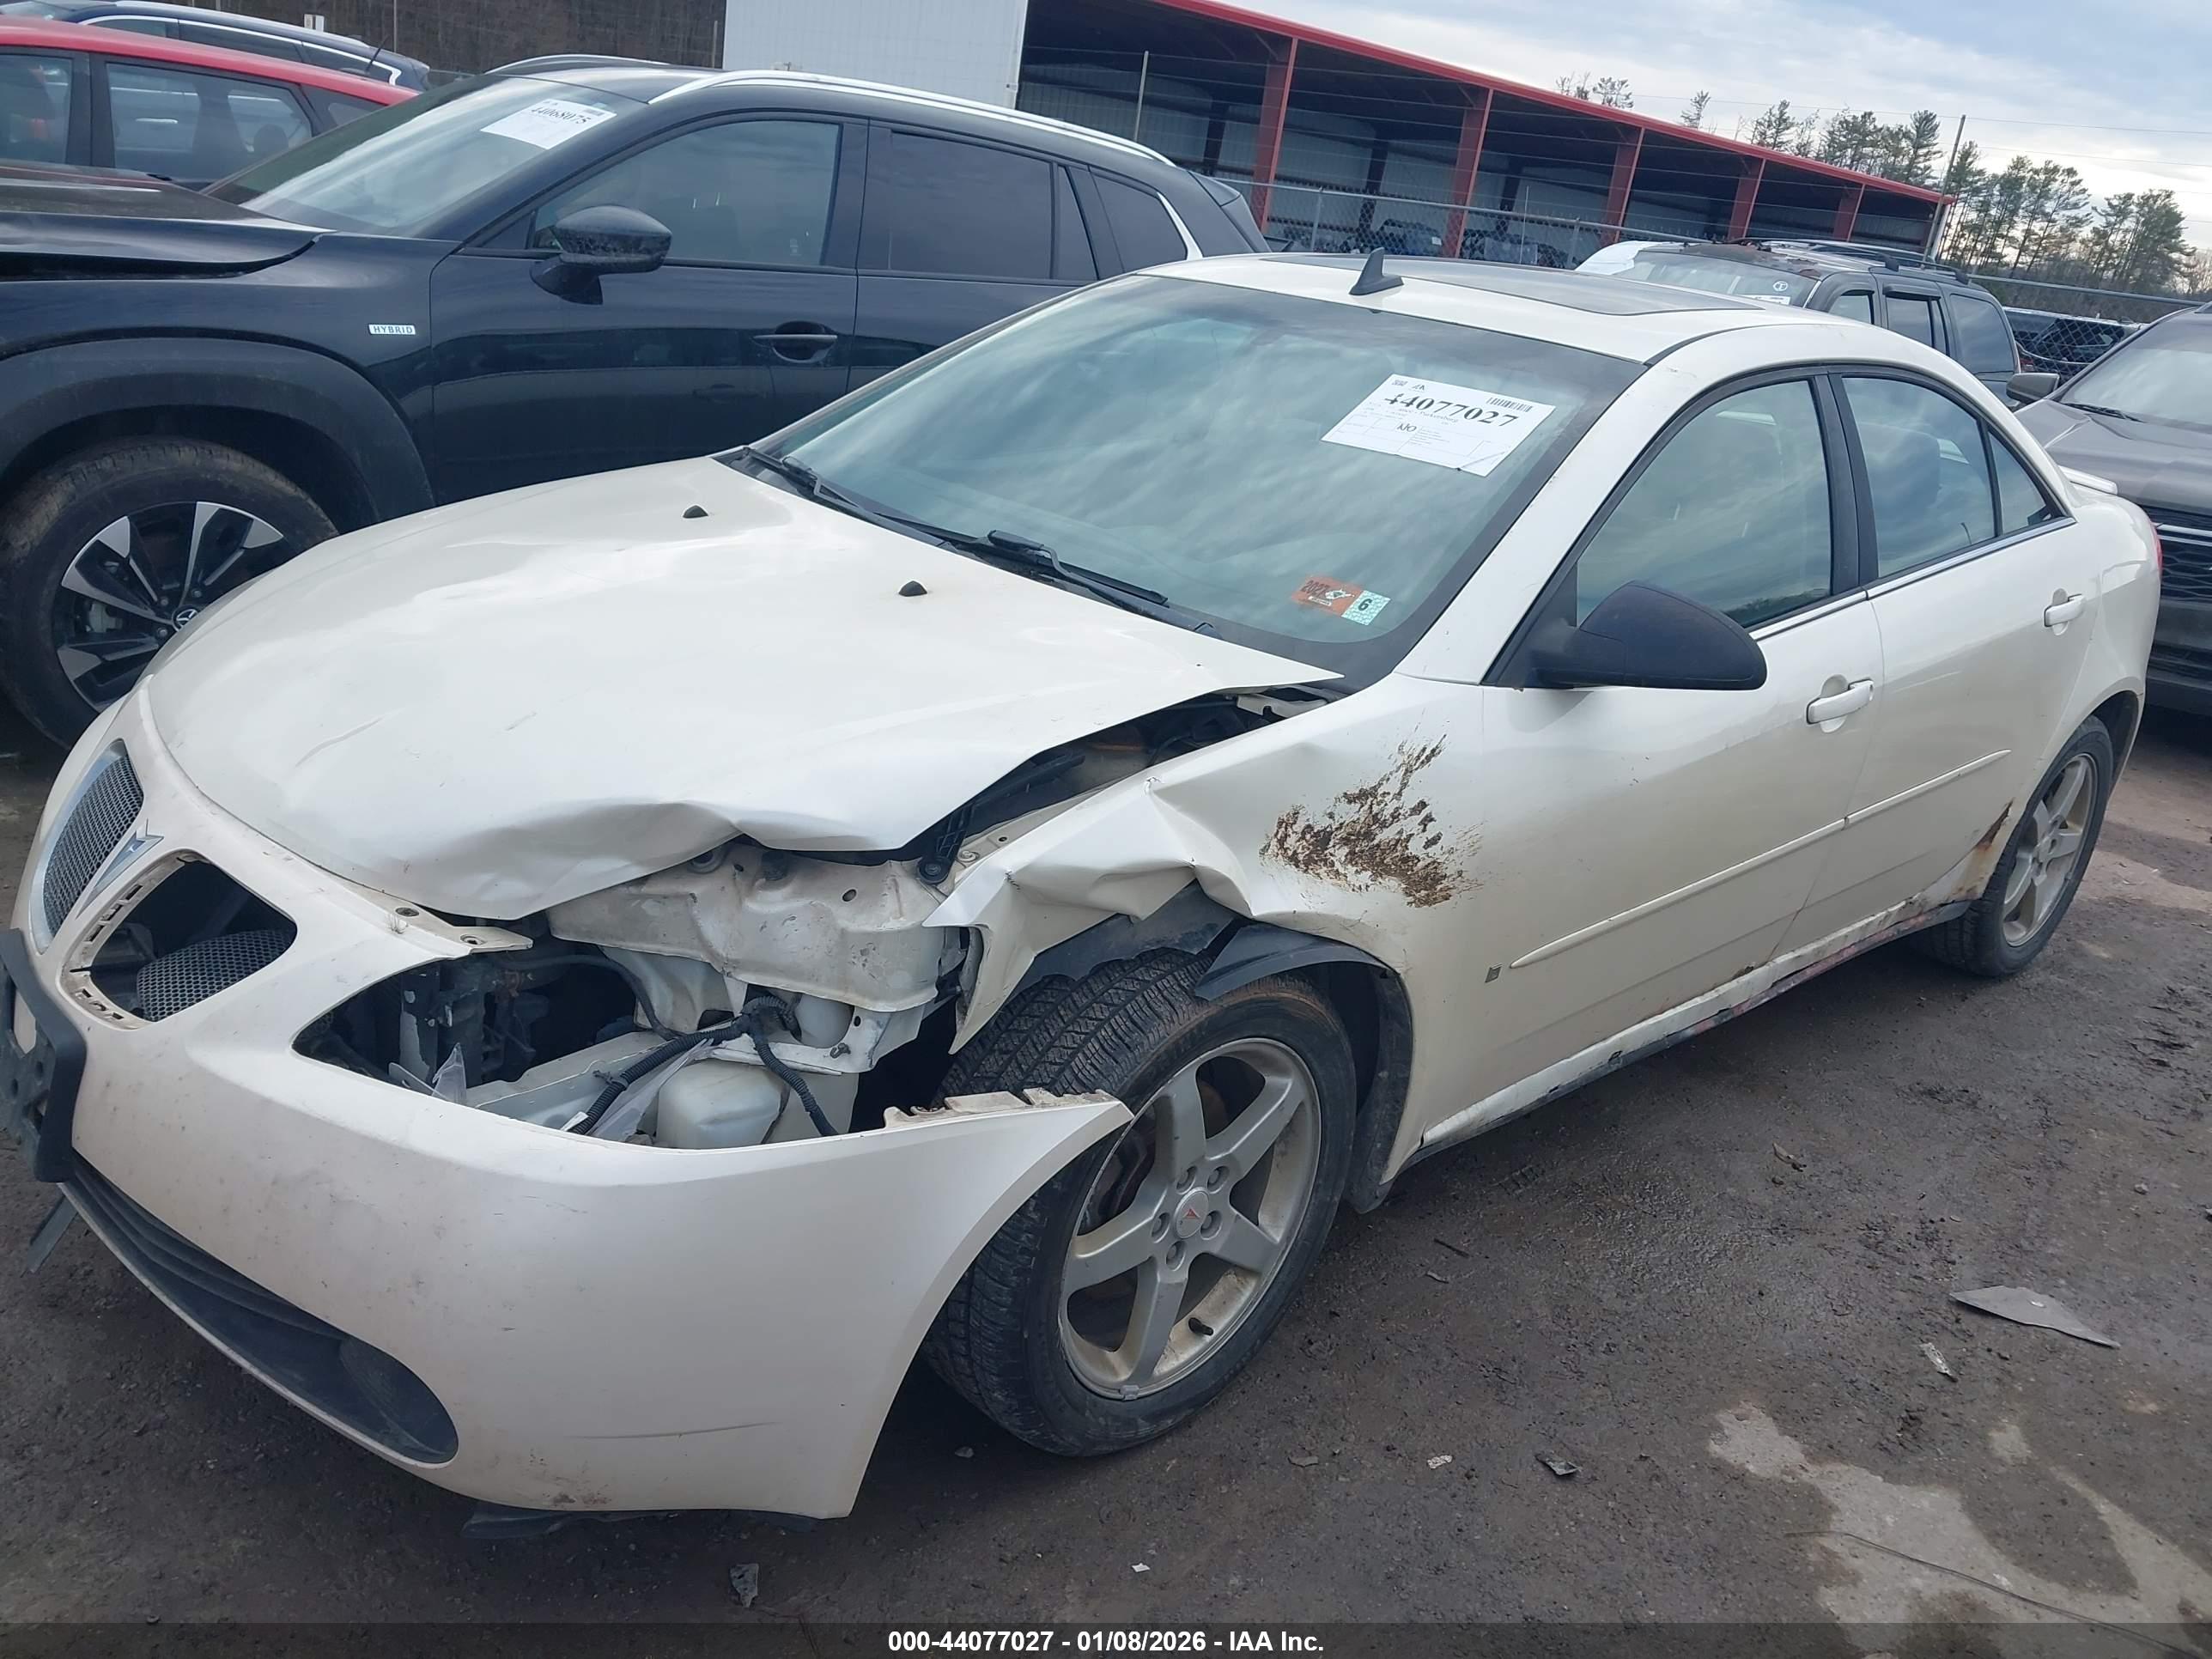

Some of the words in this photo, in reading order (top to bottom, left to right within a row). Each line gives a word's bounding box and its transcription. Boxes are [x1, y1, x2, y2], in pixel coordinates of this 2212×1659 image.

[373, 325, 414, 334] HYBRID
[1384, 392, 1520, 427] 44077027
[1358, 598, 1372, 611] 6
